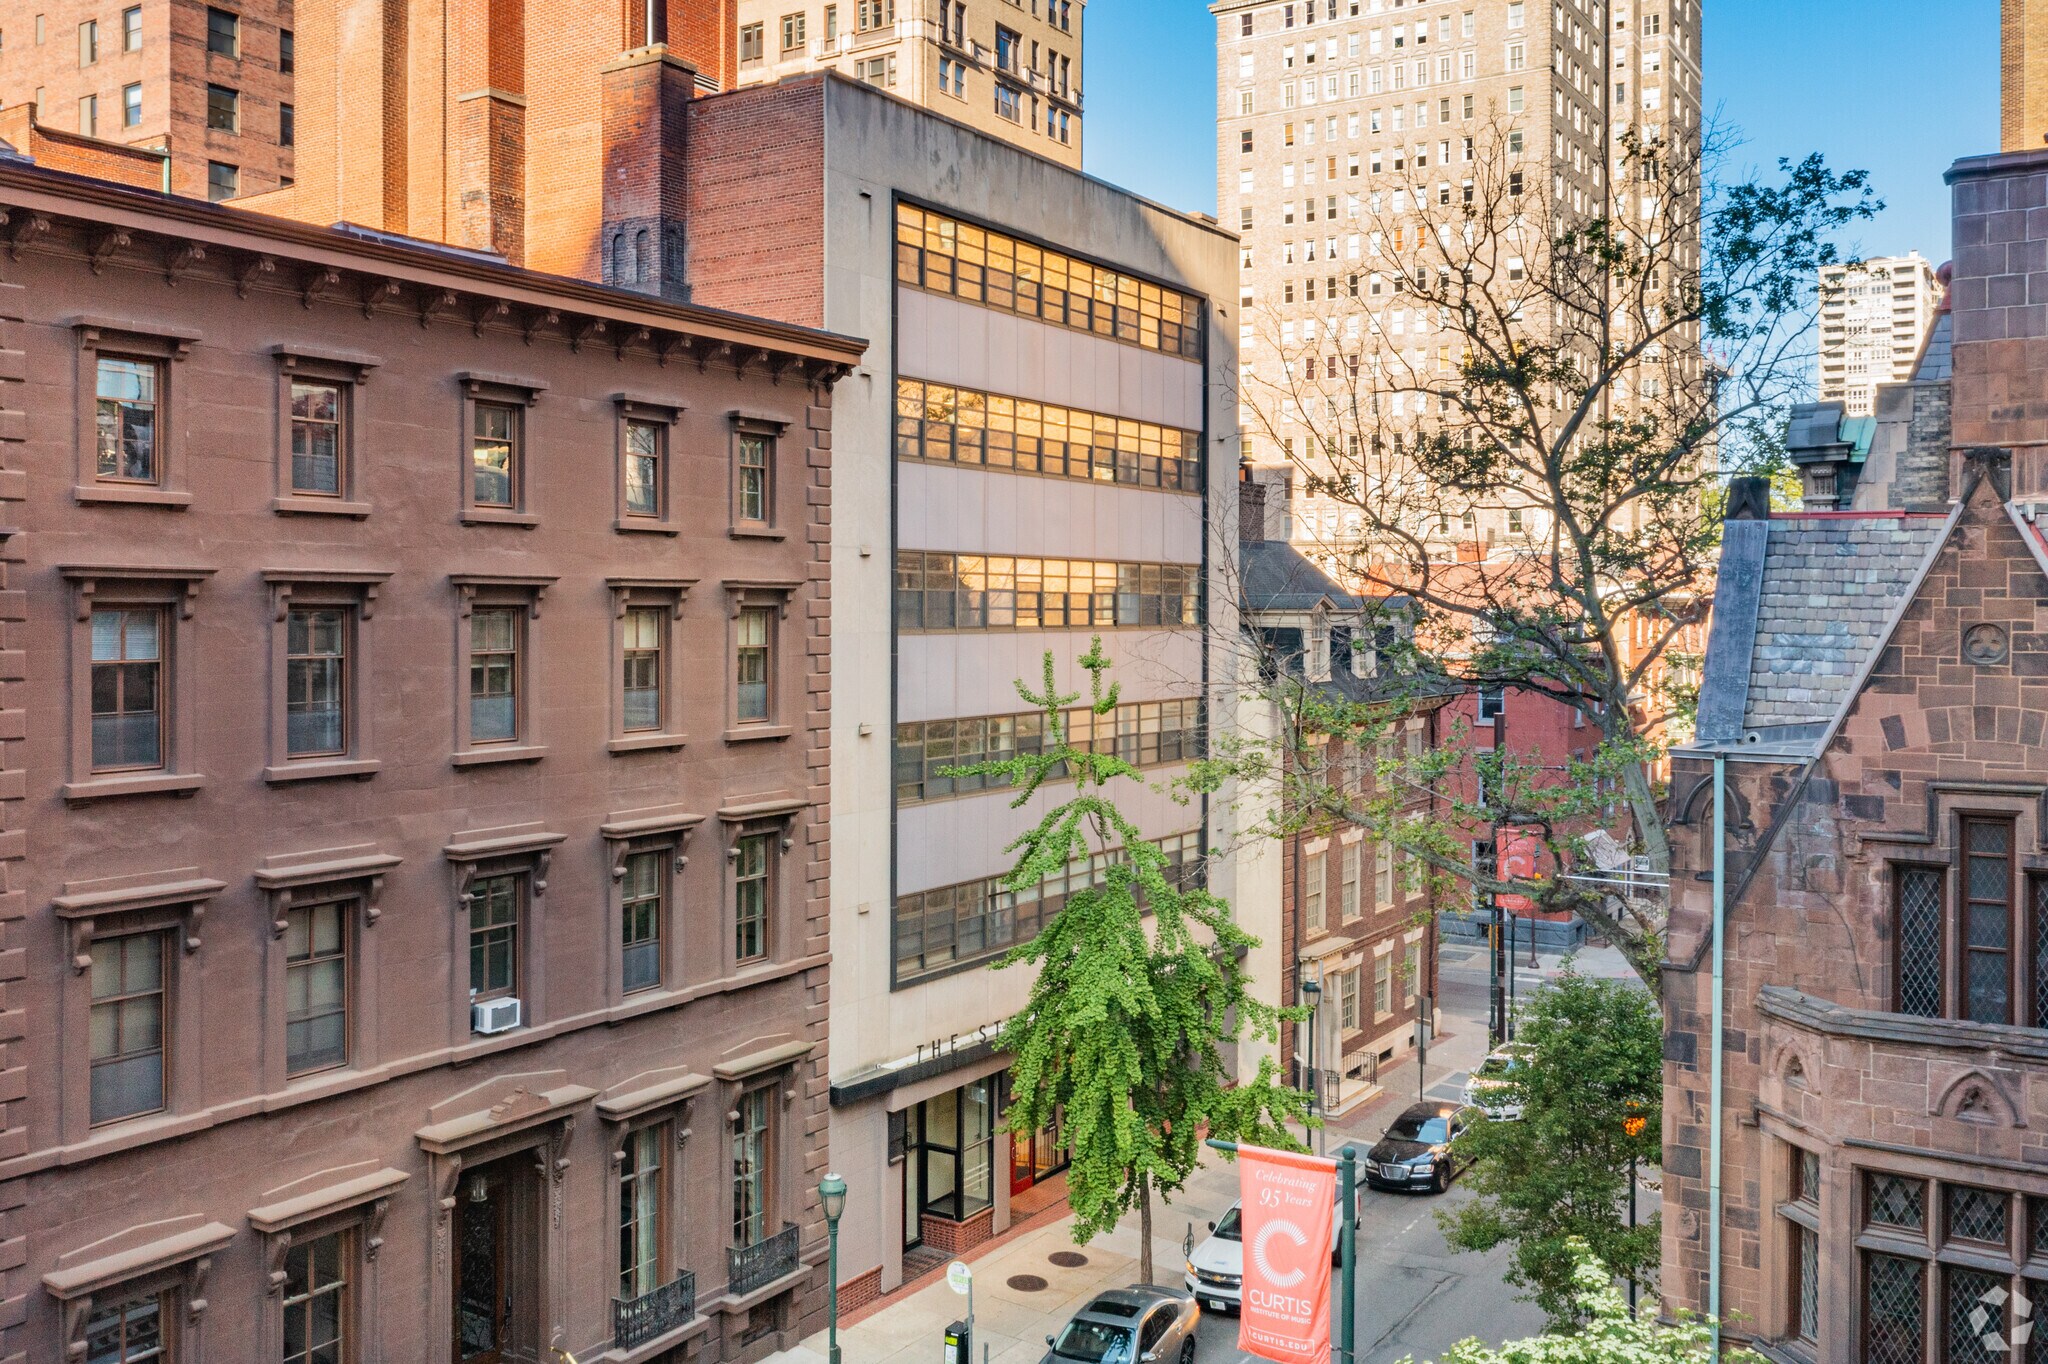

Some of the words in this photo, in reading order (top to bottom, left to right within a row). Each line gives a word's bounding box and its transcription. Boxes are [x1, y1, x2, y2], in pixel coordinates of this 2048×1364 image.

[916, 1033, 958, 1063] THE
[1255, 1168, 1317, 1194] Celebrating
[1259, 1187, 1281, 1208] 95
[1285, 1191, 1313, 1208] Years
[1249, 1289, 1312, 1316] CURTIS
[1249, 1306, 1280, 1320] INSTITUTE
[1280, 1313, 1290, 1321] OF
[1290, 1315, 1312, 1325] MUSIC
